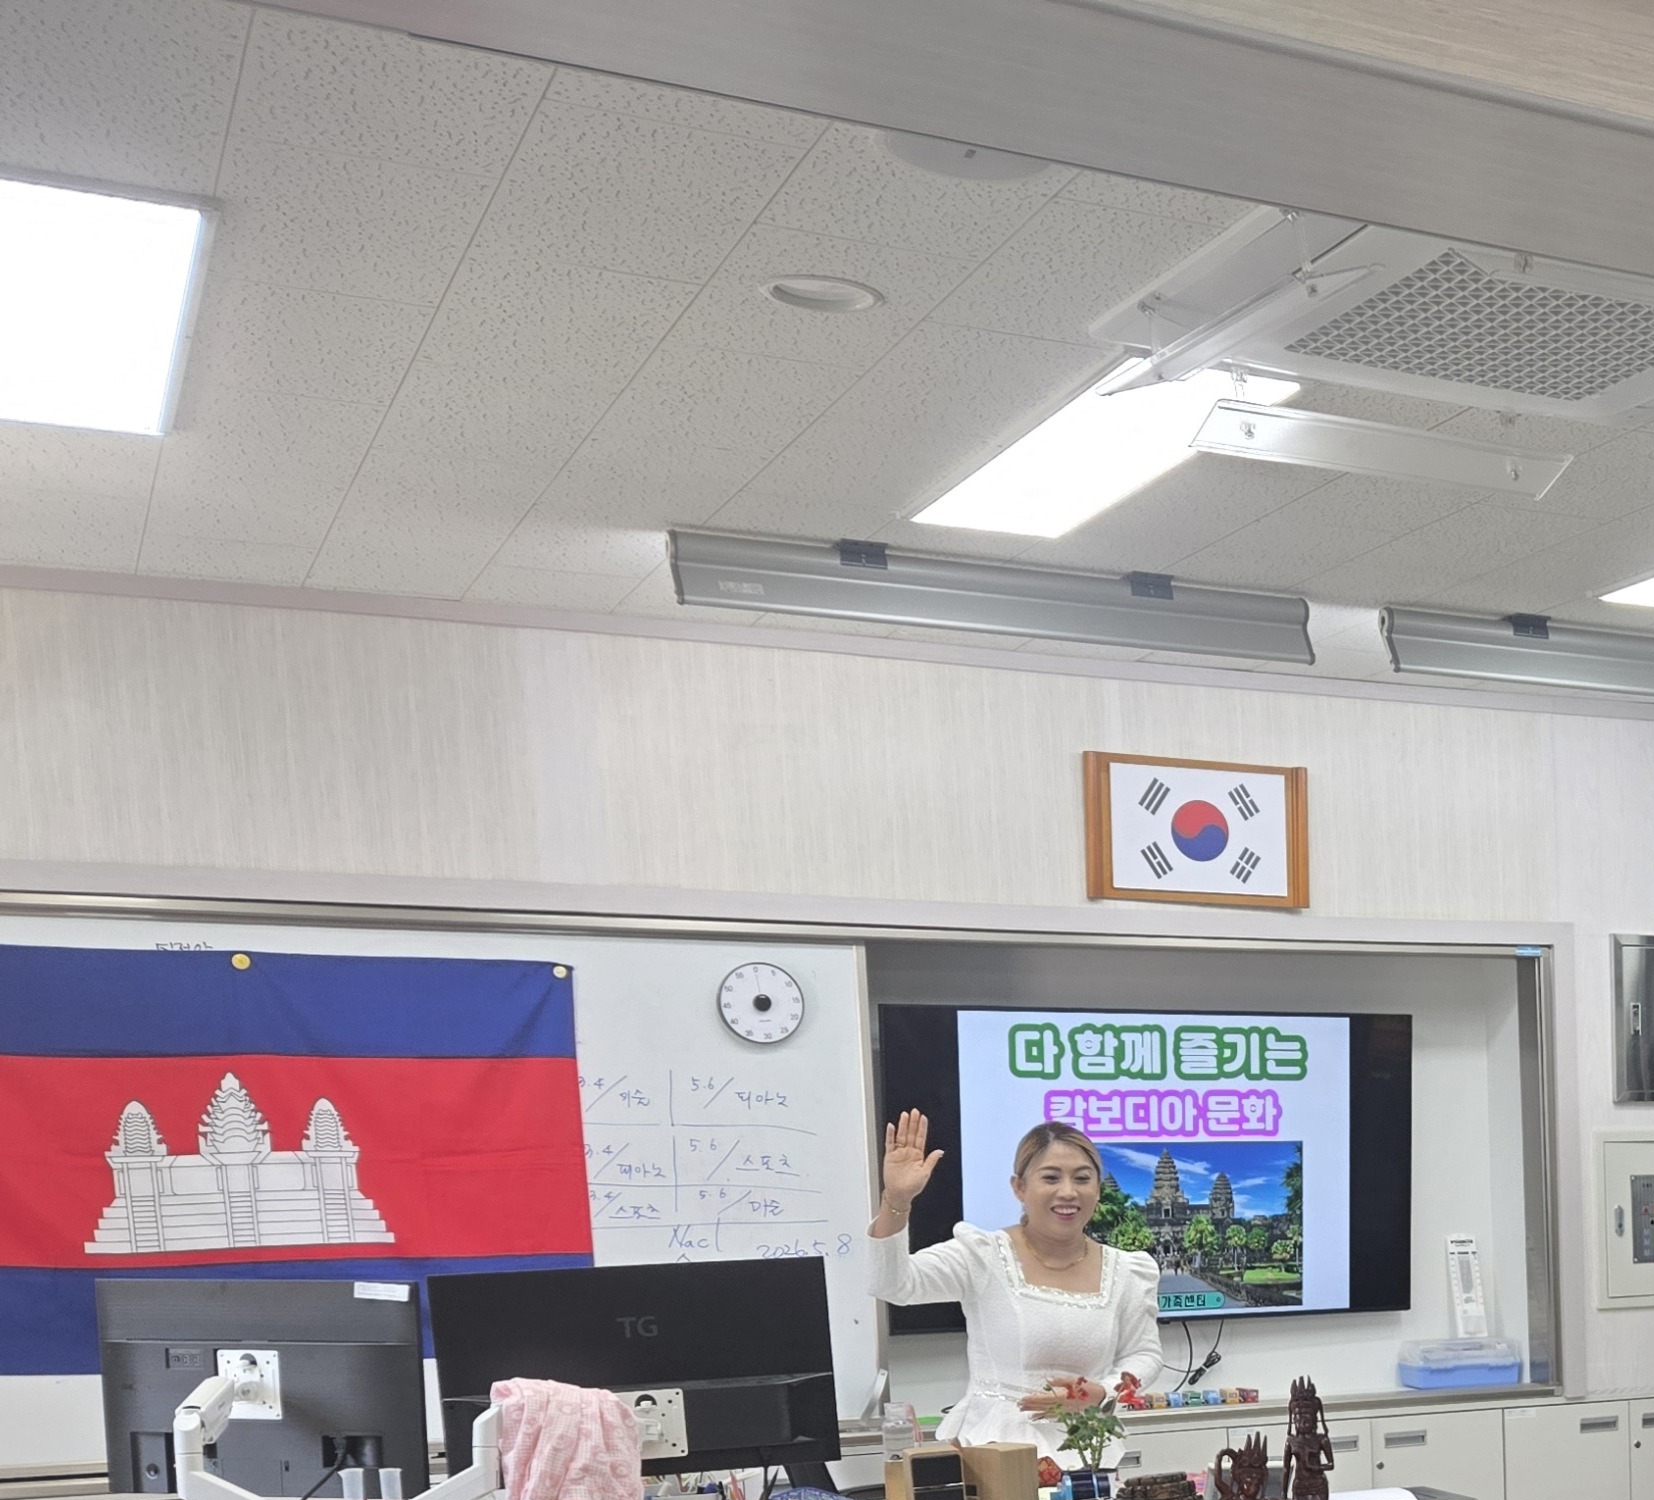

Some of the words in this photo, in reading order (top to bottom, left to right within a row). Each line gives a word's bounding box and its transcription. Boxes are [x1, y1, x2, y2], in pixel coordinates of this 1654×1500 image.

[1011, 1026, 1062, 1077] 다
[1071, 1026, 1164, 1077] 함께
[1176, 1028, 1305, 1078] 즐기는
[691, 1077, 715, 1091] 5.6
[735, 1091, 788, 1109] 피아노
[1046, 1091, 1198, 1134] 캄보디아
[1204, 1091, 1280, 1134] 문화
[617, 1163, 666, 1180] 피아노
[1158, 1293, 1206, 1308] 가족센터
[616, 1316, 658, 1338] TG
